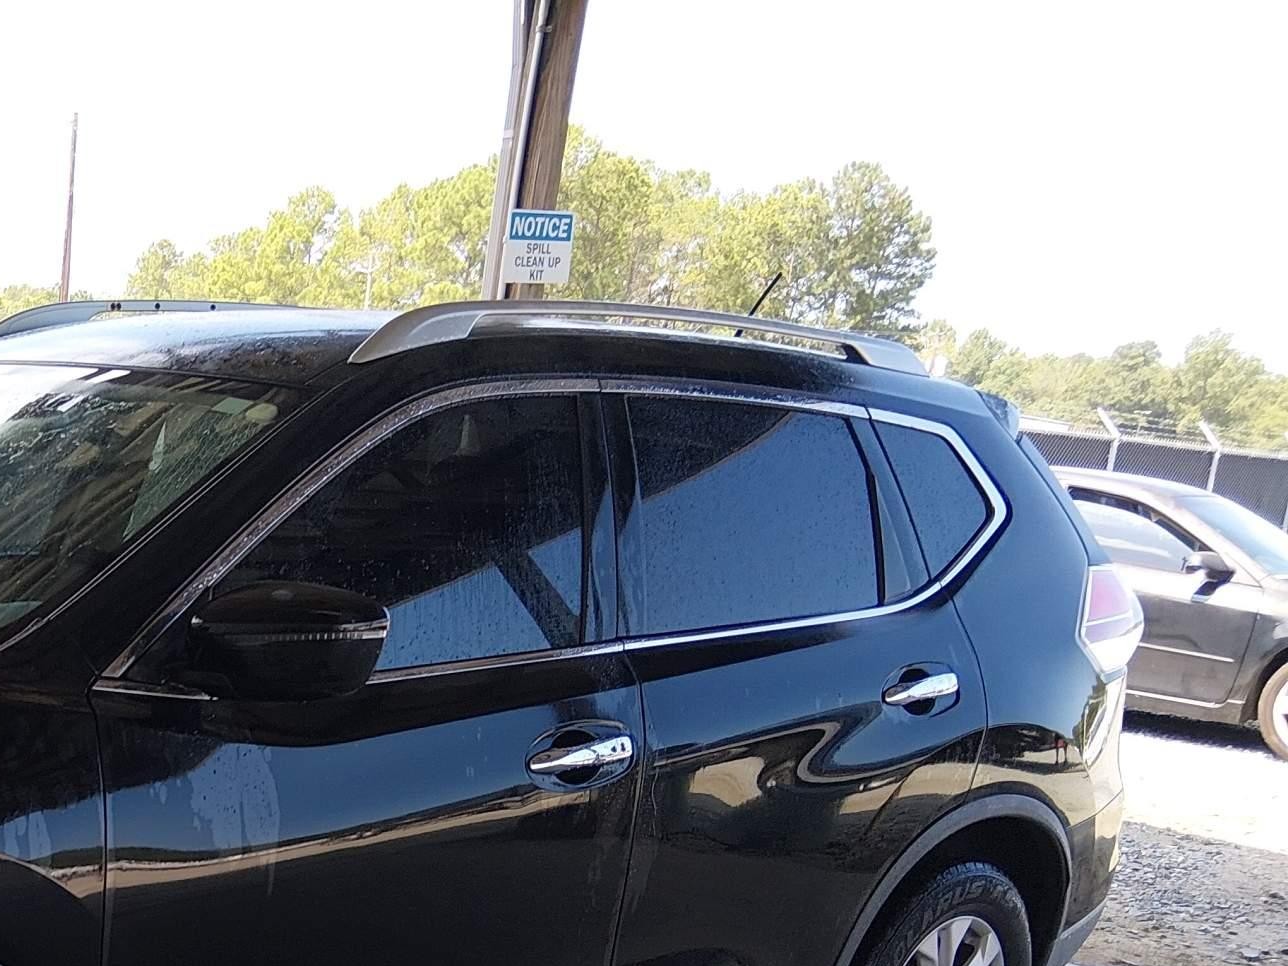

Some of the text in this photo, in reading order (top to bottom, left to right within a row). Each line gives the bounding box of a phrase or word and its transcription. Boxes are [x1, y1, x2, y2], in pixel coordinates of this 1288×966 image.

[512, 216, 571, 238] NOTICE
[526, 243, 552, 255] SPILL
[514, 256, 561, 268] CLEAN UP
[529, 270, 544, 281] KIT
